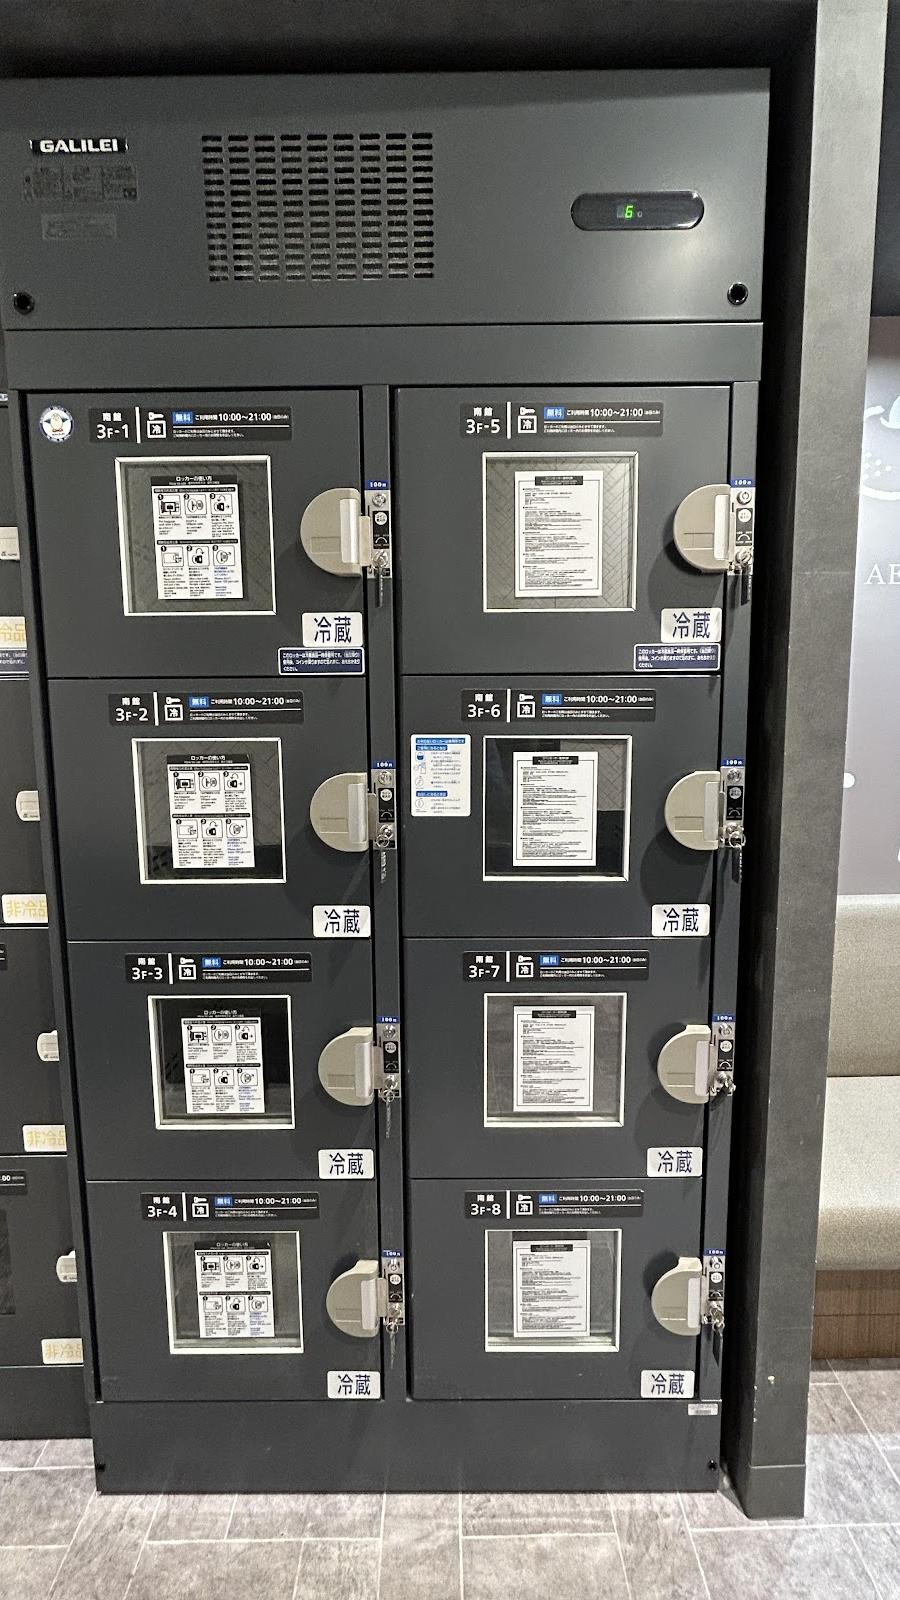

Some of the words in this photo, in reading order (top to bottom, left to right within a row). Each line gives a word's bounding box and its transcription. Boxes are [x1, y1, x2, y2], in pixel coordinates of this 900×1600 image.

[40, 139, 118, 152] GALILEI
[625, 205, 633, 218] 6
[97, 424, 128, 439] 3F-1
[466, 419, 500, 434] 3F-5
[314, 616, 351, 643] 冷蔵
[673, 612, 710, 638] 冷蔵
[116, 708, 148, 721] 3F-2
[468, 704, 500, 717] 3F-6
[325, 909, 359, 933] 冷蔵
[663, 908, 698, 932] 冷蔵
[132, 967, 162, 980] 3F-3
[469, 965, 500, 978] 3F-7
[329, 1153, 363, 1175] 冷蔵
[658, 1151, 692, 1173] 冷蔵
[148, 1206, 177, 1217] 3F-4
[471, 1204, 501, 1215] 3F-8
[338, 1374, 370, 1395] 冷蔵
[651, 1373, 684, 1394] 冷蔵
